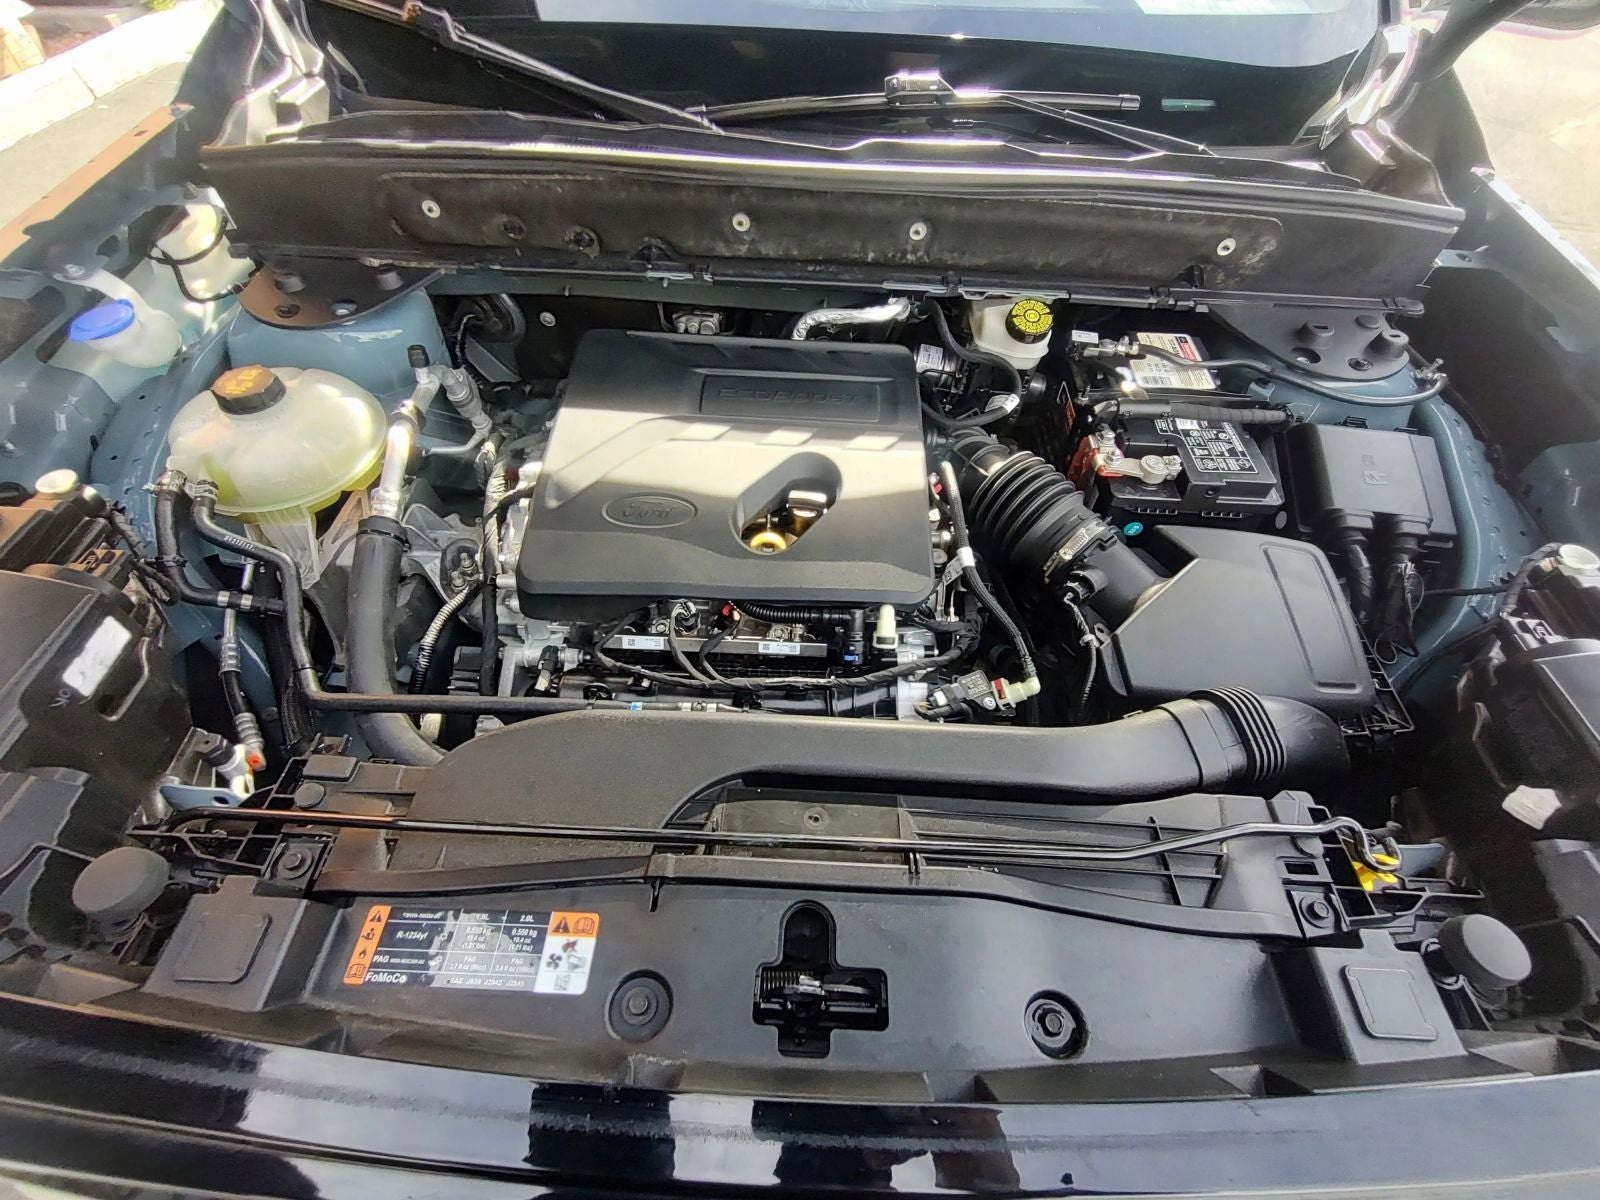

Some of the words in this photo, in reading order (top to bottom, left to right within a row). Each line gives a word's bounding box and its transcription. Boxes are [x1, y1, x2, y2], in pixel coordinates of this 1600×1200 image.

[620, 500, 679, 519] Ford
[519, 914, 535, 922] 2.0L
[529, 929, 538, 938] kg
[372, 955, 389, 963] PAG
[510, 957, 524, 965] PAG
[364, 971, 408, 983] FoMoCo
